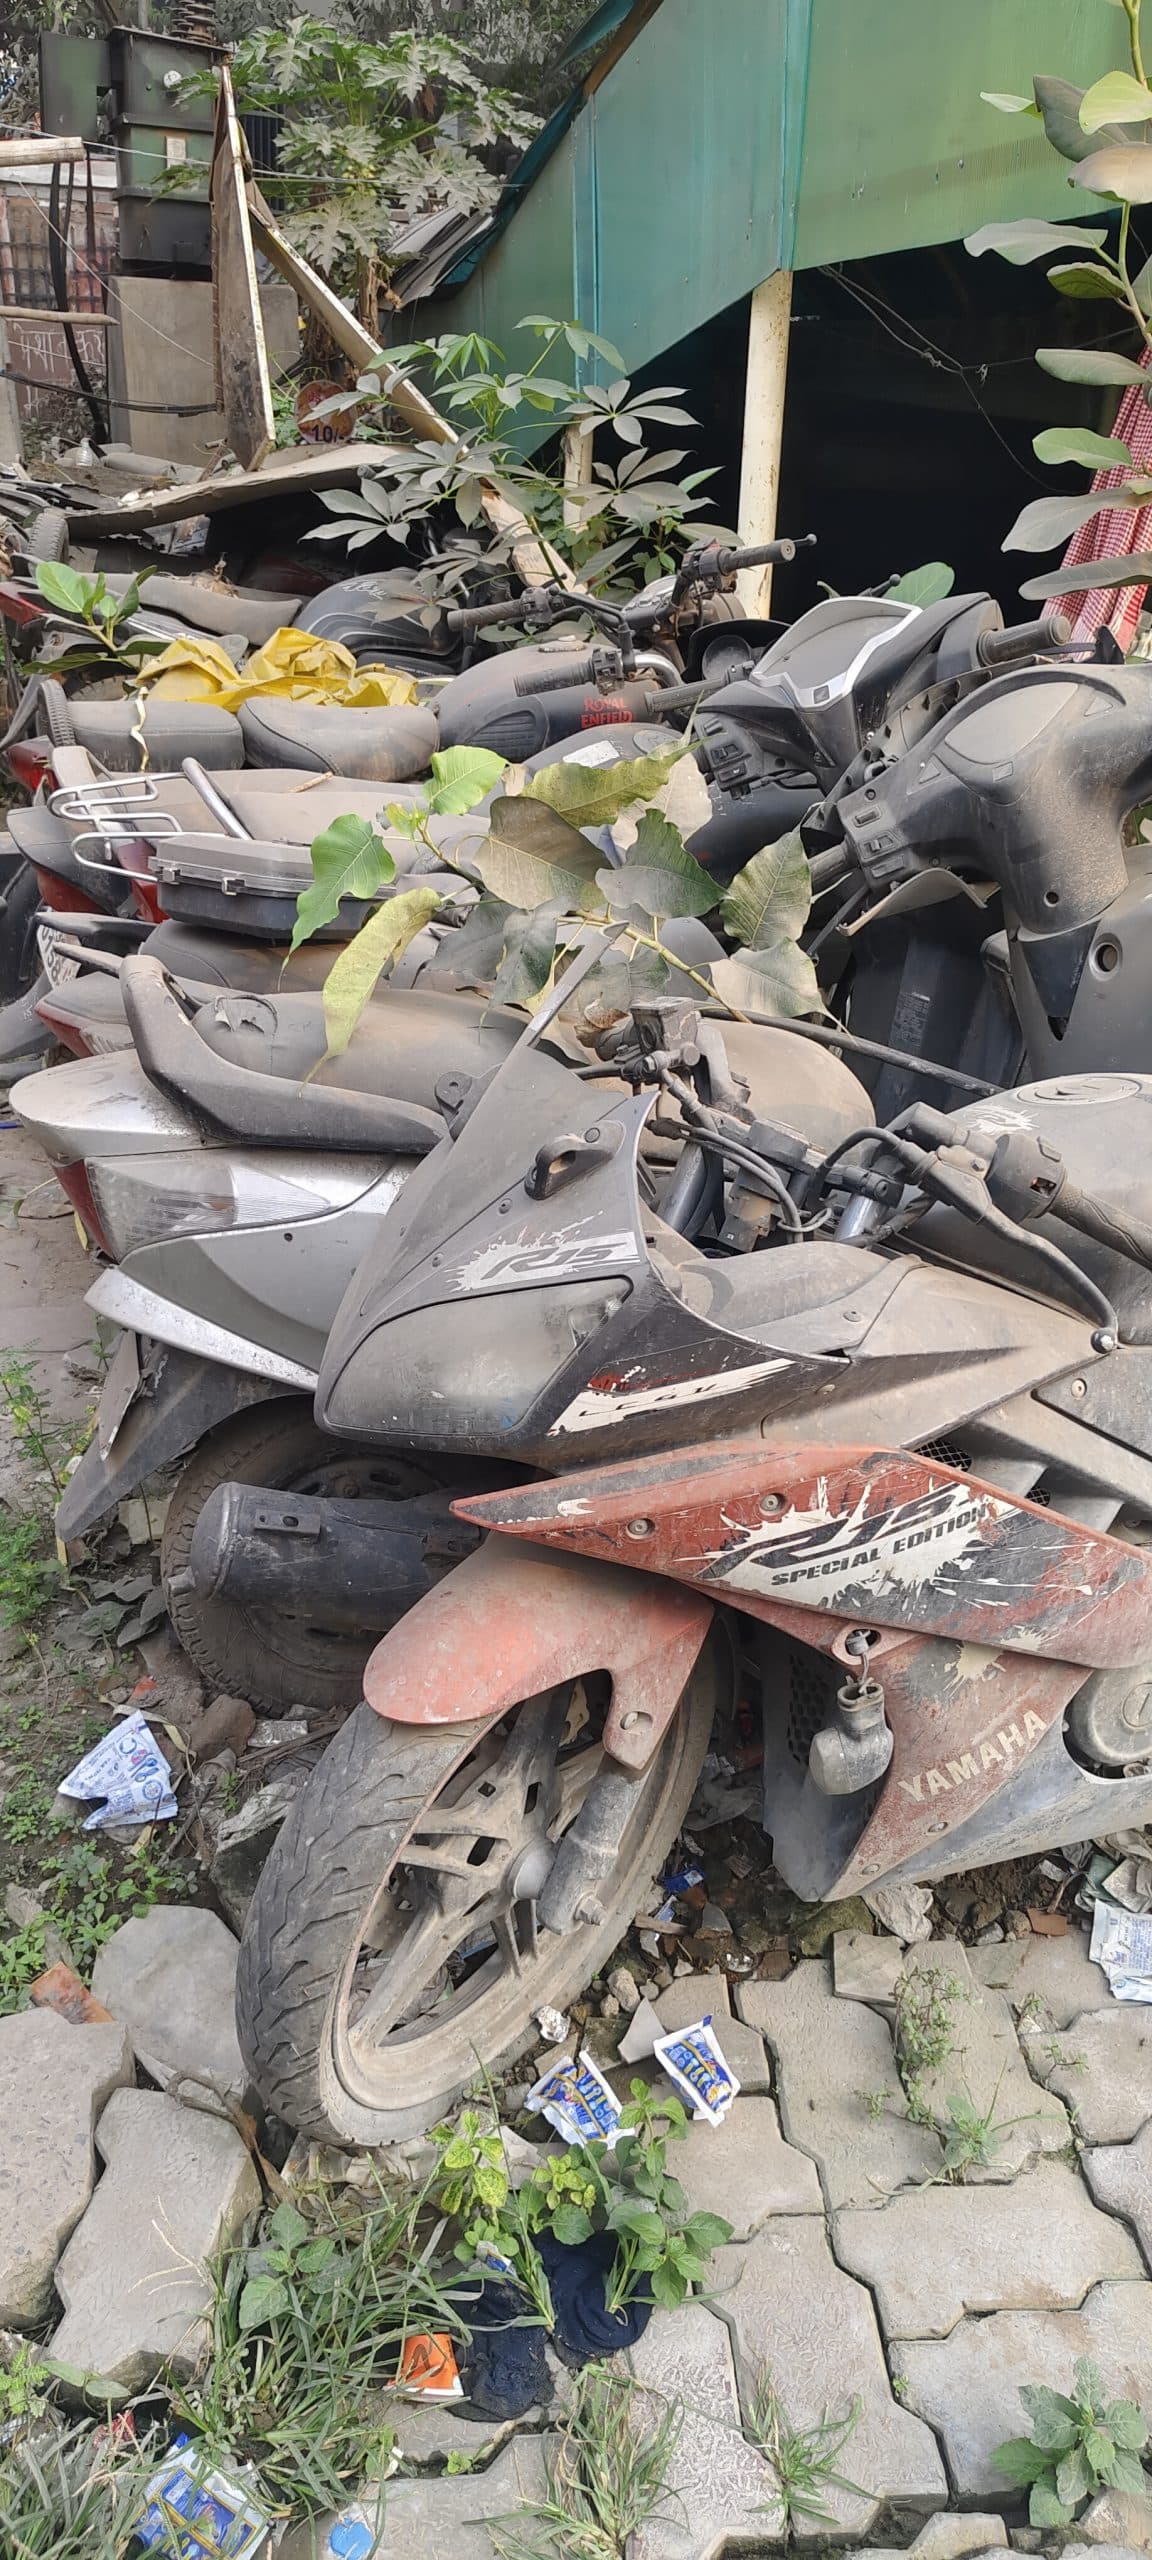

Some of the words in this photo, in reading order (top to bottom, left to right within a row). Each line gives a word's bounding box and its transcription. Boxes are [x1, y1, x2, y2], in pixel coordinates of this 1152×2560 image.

[581, 711, 634, 729] ENFIELD
[584, 697, 628, 712] ROYAL
[771, 1548, 881, 1586] SPECIAL
[893, 1503, 986, 1554] EDITION
[897, 1709, 1048, 1802] YAMAHA
